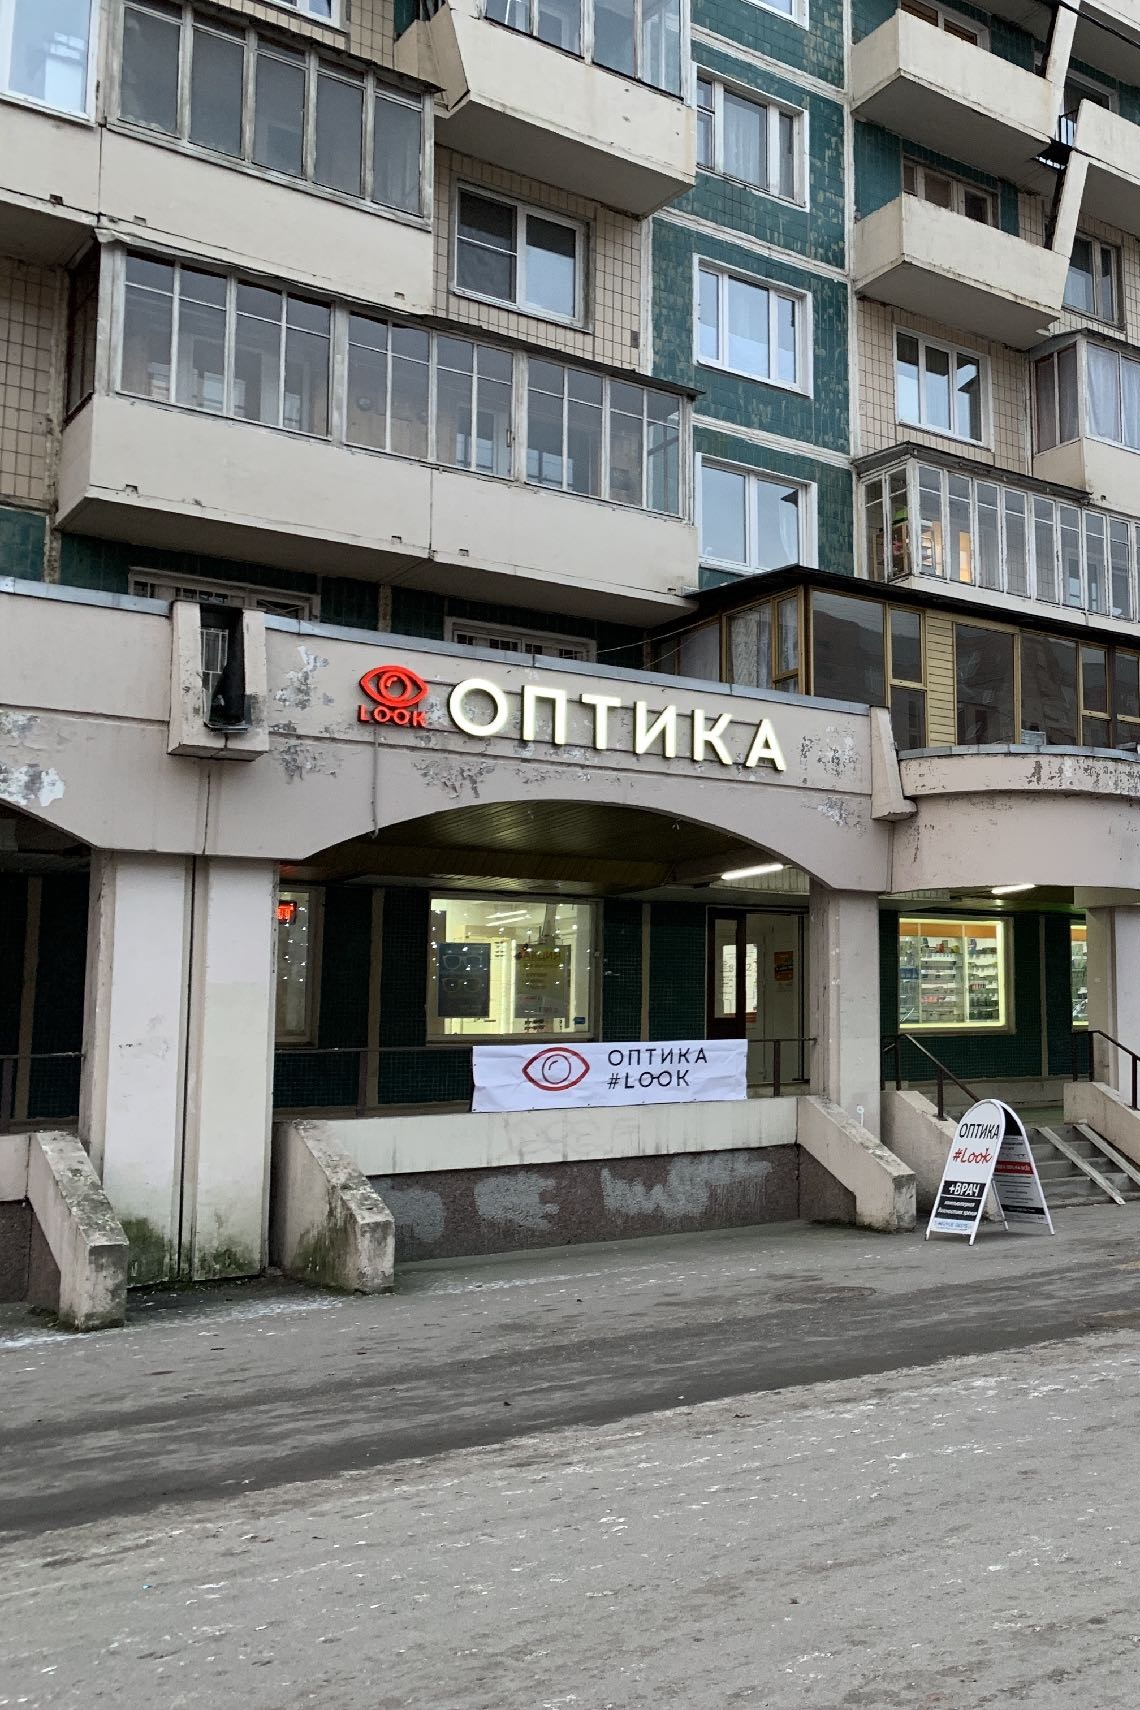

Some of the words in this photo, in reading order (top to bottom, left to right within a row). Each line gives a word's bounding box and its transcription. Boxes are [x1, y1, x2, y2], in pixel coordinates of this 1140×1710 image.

[358, 704, 427, 727] LOOK
[449, 678, 787, 771] ОПТИКА
[608, 1047, 708, 1066] ОПТИКА
[607, 1069, 689, 1090] #LOOK
[959, 1123, 1000, 1139] ОПТИКА
[948, 1182, 981, 1195] +ВРАЧ
